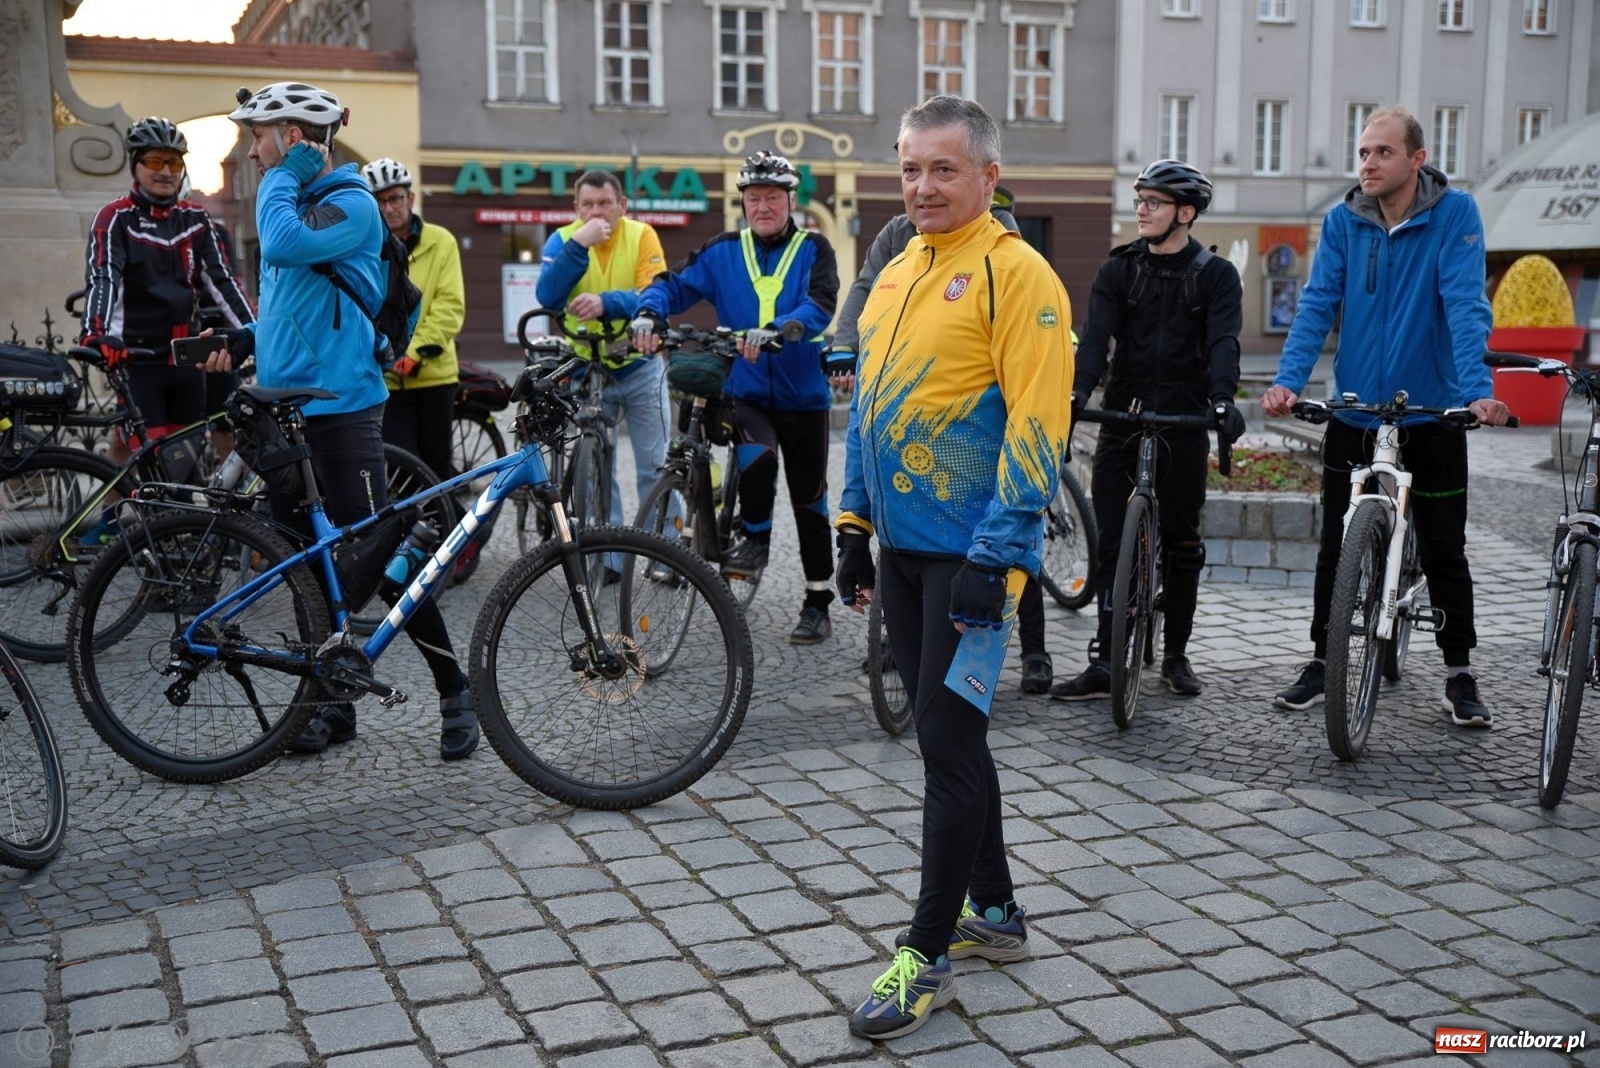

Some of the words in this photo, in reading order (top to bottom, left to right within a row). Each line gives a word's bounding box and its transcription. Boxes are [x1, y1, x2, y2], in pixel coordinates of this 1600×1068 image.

[453, 161, 707, 199] APTKA
[1538, 194, 1600, 220] 1567
[378, 486, 498, 629] TREK
[73, 604, 94, 703] SCHWALBE
[966, 675, 988, 694] FORZA
[700, 665, 743, 759] SCHWALBE
